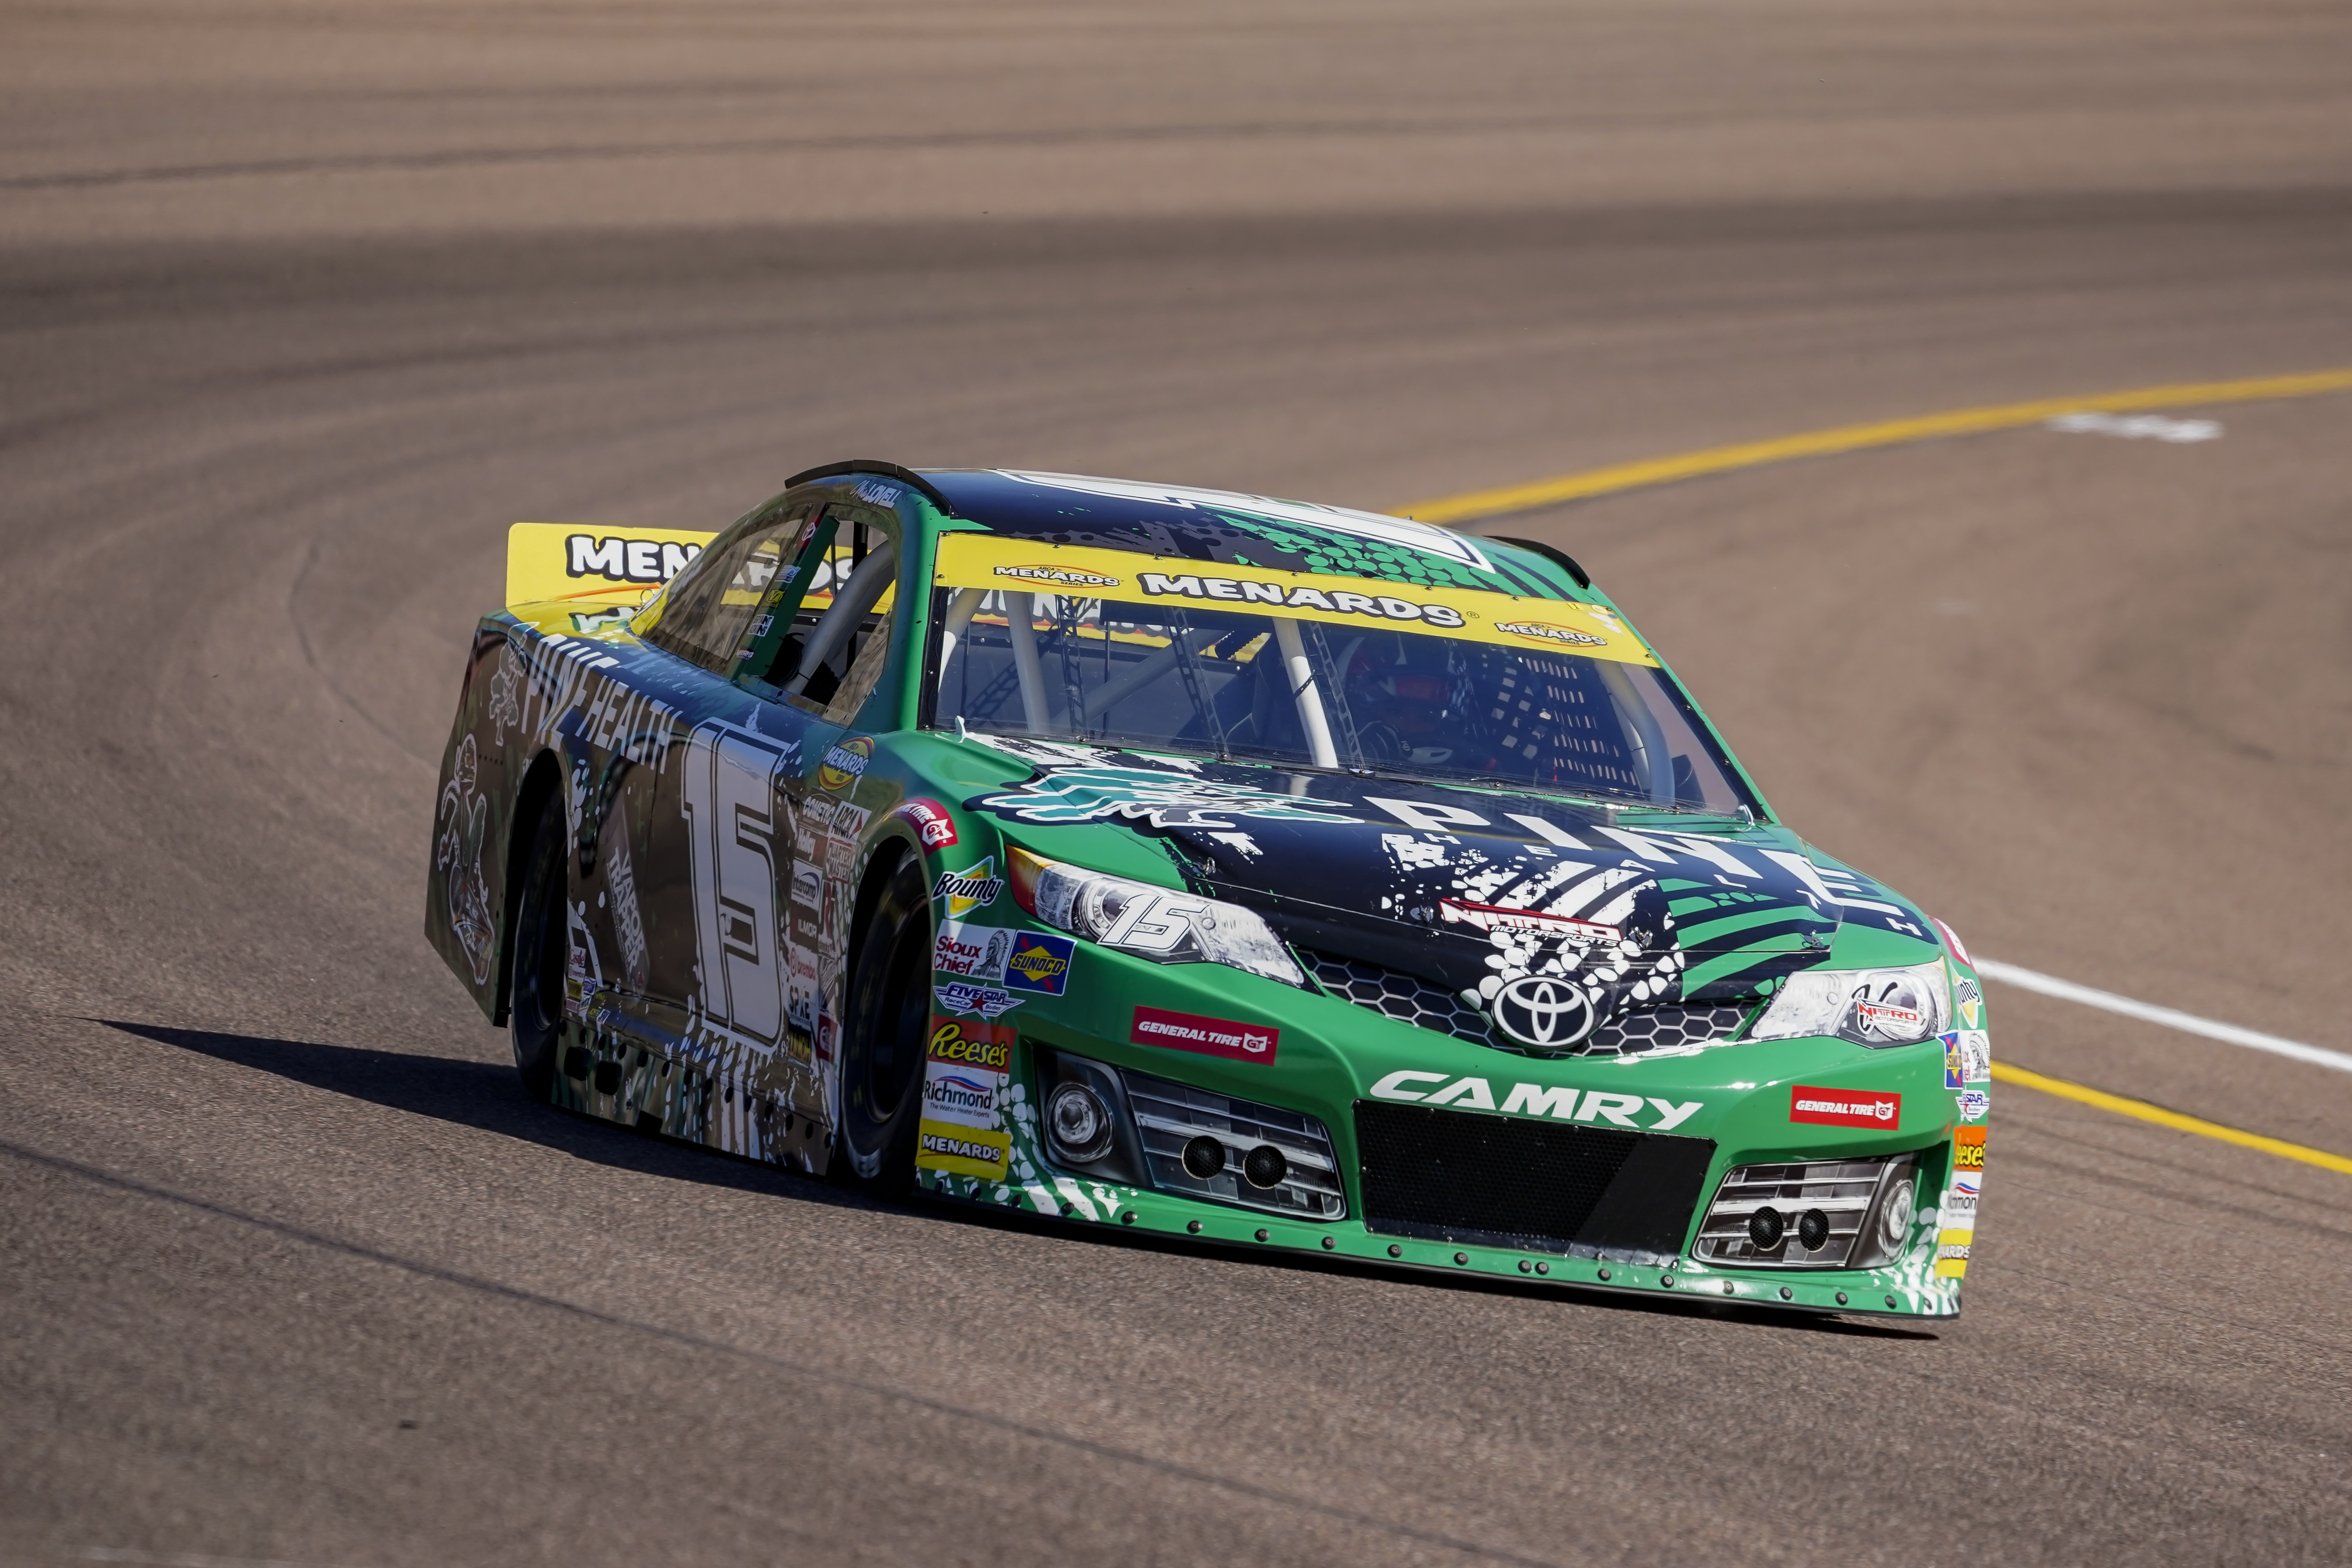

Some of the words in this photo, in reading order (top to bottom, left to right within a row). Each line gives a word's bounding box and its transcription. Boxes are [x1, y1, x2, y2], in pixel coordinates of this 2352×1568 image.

[993, 566, 1120, 586] MENARDS
[1136, 573, 1466, 628] MENARDS
[1494, 622, 1608, 646] MENARDS
[575, 675, 684, 774] HEALTH
[823, 745, 869, 776] MENARDS
[621, 849, 645, 952] VAPOR
[933, 873, 1003, 904] Bounty
[609, 847, 640, 975] TRAPPER
[1096, 894, 1210, 952] 15
[1439, 901, 1623, 942] NITRO
[798, 918, 817, 939] ILMOR
[1490, 924, 1619, 946] MOTORSPORTS
[936, 935, 983, 959] Sioux
[934, 953, 975, 975] Chief
[1011, 954, 1065, 975] SUNOCO
[948, 984, 981, 999] FIVE
[983, 991, 1007, 1004] STAR
[1858, 1001, 1918, 1021] NITRO
[929, 1024, 1009, 1067] Reese's
[1138, 1021, 1207, 1042] GENERAL
[1208, 1032, 1243, 1047] TIRE
[924, 1080, 993, 1110] Richmond
[1370, 1070, 1704, 1131] CAMRY
[1795, 1099, 1849, 1114] GENERAL
[1849, 1103, 1876, 1116] TIRE
[939, 1104, 956, 1112] Water
[957, 1107, 973, 1115] Heater
[973, 1110, 990, 1118] Experts
[922, 1133, 1001, 1162] MENARDS
